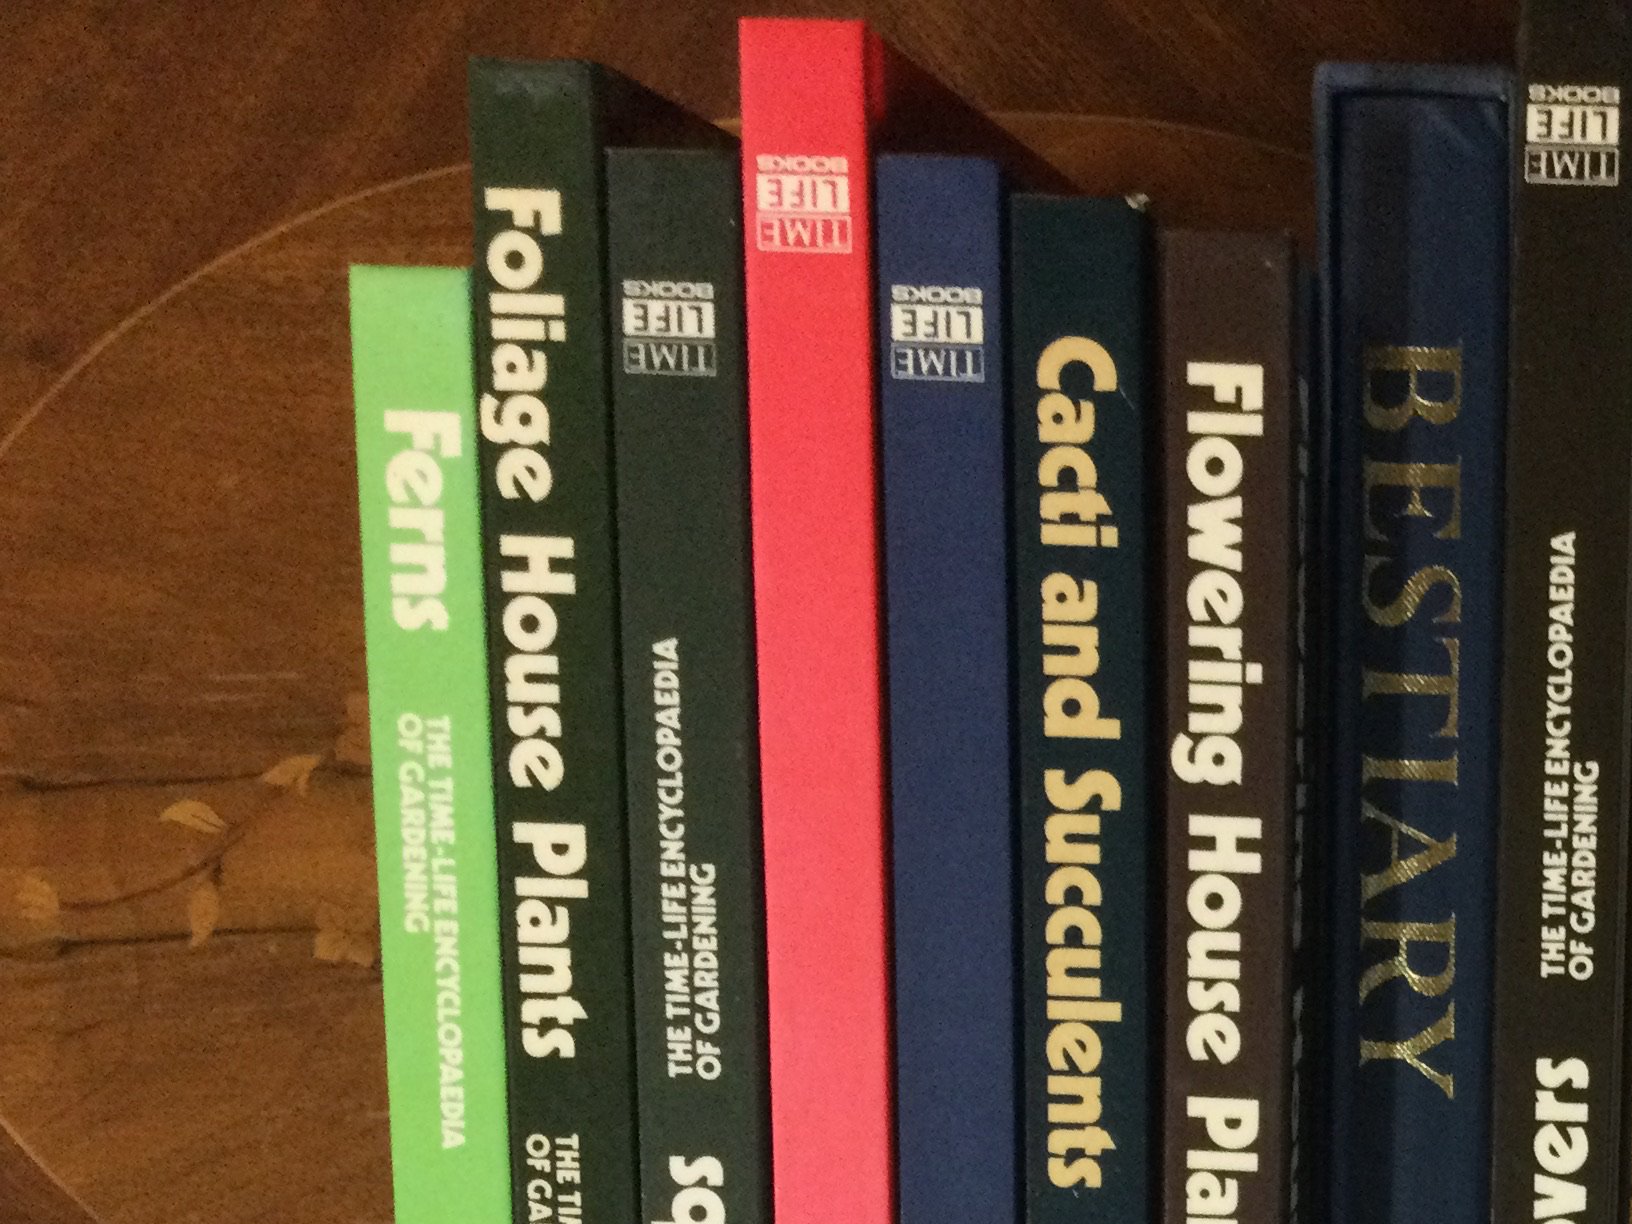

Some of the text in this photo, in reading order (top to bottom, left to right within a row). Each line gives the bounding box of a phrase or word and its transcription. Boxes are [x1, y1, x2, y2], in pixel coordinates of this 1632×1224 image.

[1529, 84, 1620, 103] BOOKS
[1537, 110, 1607, 139] LIFE
[757, 154, 848, 173] BOOKS
[1531, 151, 1616, 181] TIME
[767, 178, 839, 209] LIFE
[762, 217, 849, 248] TIME
[623, 280, 714, 300] BOOKS
[891, 285, 982, 304] BOOKS
[632, 303, 708, 334] LIFE
[902, 309, 972, 340] LIFE
[627, 343, 711, 372] TIME
[896, 349, 980, 377] TIME
[384, 409, 462, 632] Ferns
[1170, 361, 1264, 785] Flowering
[480, 187, 589, 1059] Foliage House Plants
[1359, 337, 1464, 1100] BESTIARY
[1036, 336, 1122, 1190] Cacti and Succulents
[1540, 531, 1578, 979] THE TIME-LIFE ENCYCLOPAEDIA
[397, 713, 430, 934] OF GARDENING
[652, 637, 693, 1078] THE TIME-LIFE ENCYCLOPAEDIA
[1568, 759, 1600, 981] OF GARDENING
[424, 714, 466, 1150] THE TIME-LIFE ENCYCLOPAEDIA
[1186, 814, 1262, 1065] House
[689, 863, 722, 1081] OF GARDENING
[526, 1133, 552, 1172] OF
[555, 1133, 581, 1183] THE
